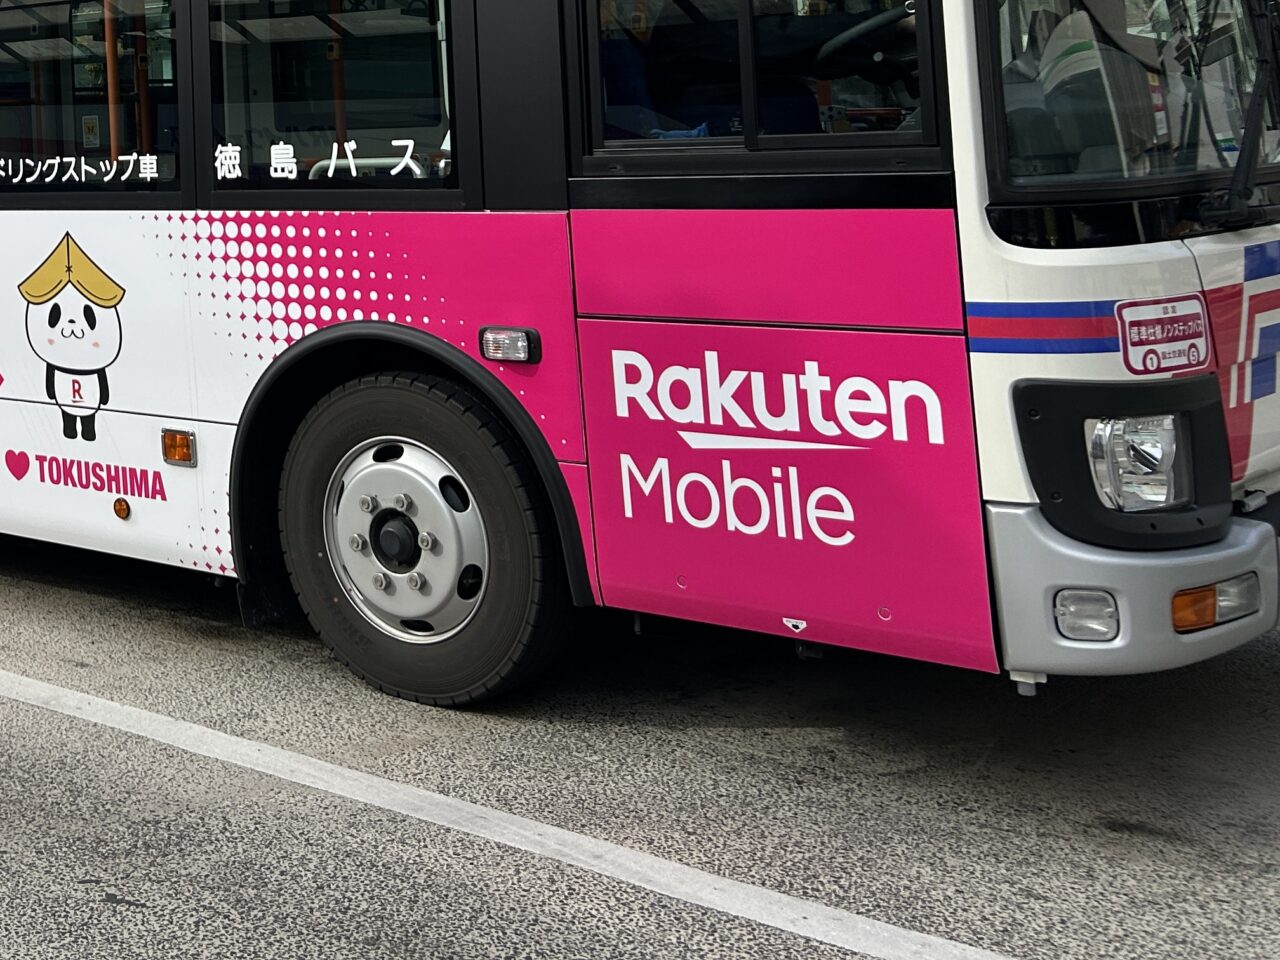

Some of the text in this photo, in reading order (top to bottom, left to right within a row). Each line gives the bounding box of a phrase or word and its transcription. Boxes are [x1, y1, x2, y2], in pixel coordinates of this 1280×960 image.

[214, 139, 421, 180] 徳島バス
[72, 379, 84, 400] R
[611, 349, 945, 445] Rakuten
[35, 454, 168, 501] TOKUSHIMA
[619, 453, 856, 546] Mobile
